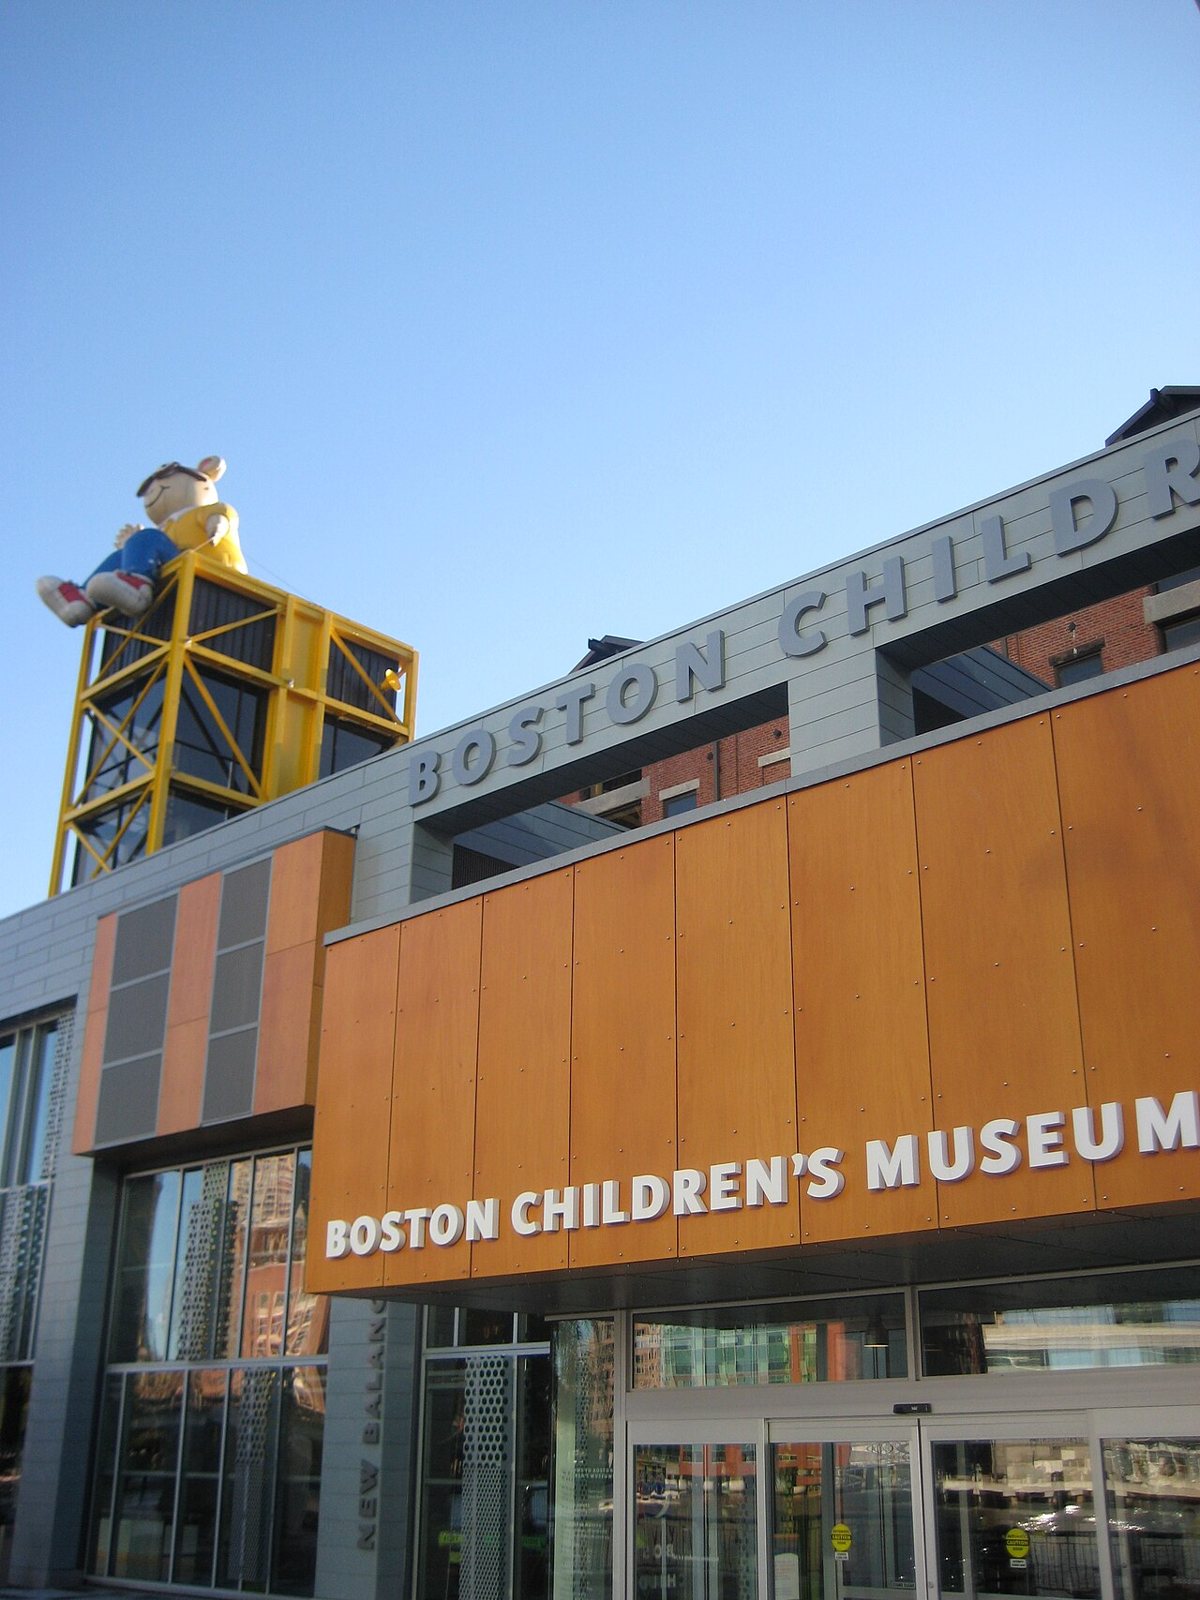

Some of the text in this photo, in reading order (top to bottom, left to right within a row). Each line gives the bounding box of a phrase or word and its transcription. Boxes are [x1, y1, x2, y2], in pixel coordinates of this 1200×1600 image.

[408, 629, 726, 807] BOSTON
[326, 1090, 1200, 1259] BOSTON CHILDREN'S MUSEUM
[357, 1459, 379, 1551] NEW
